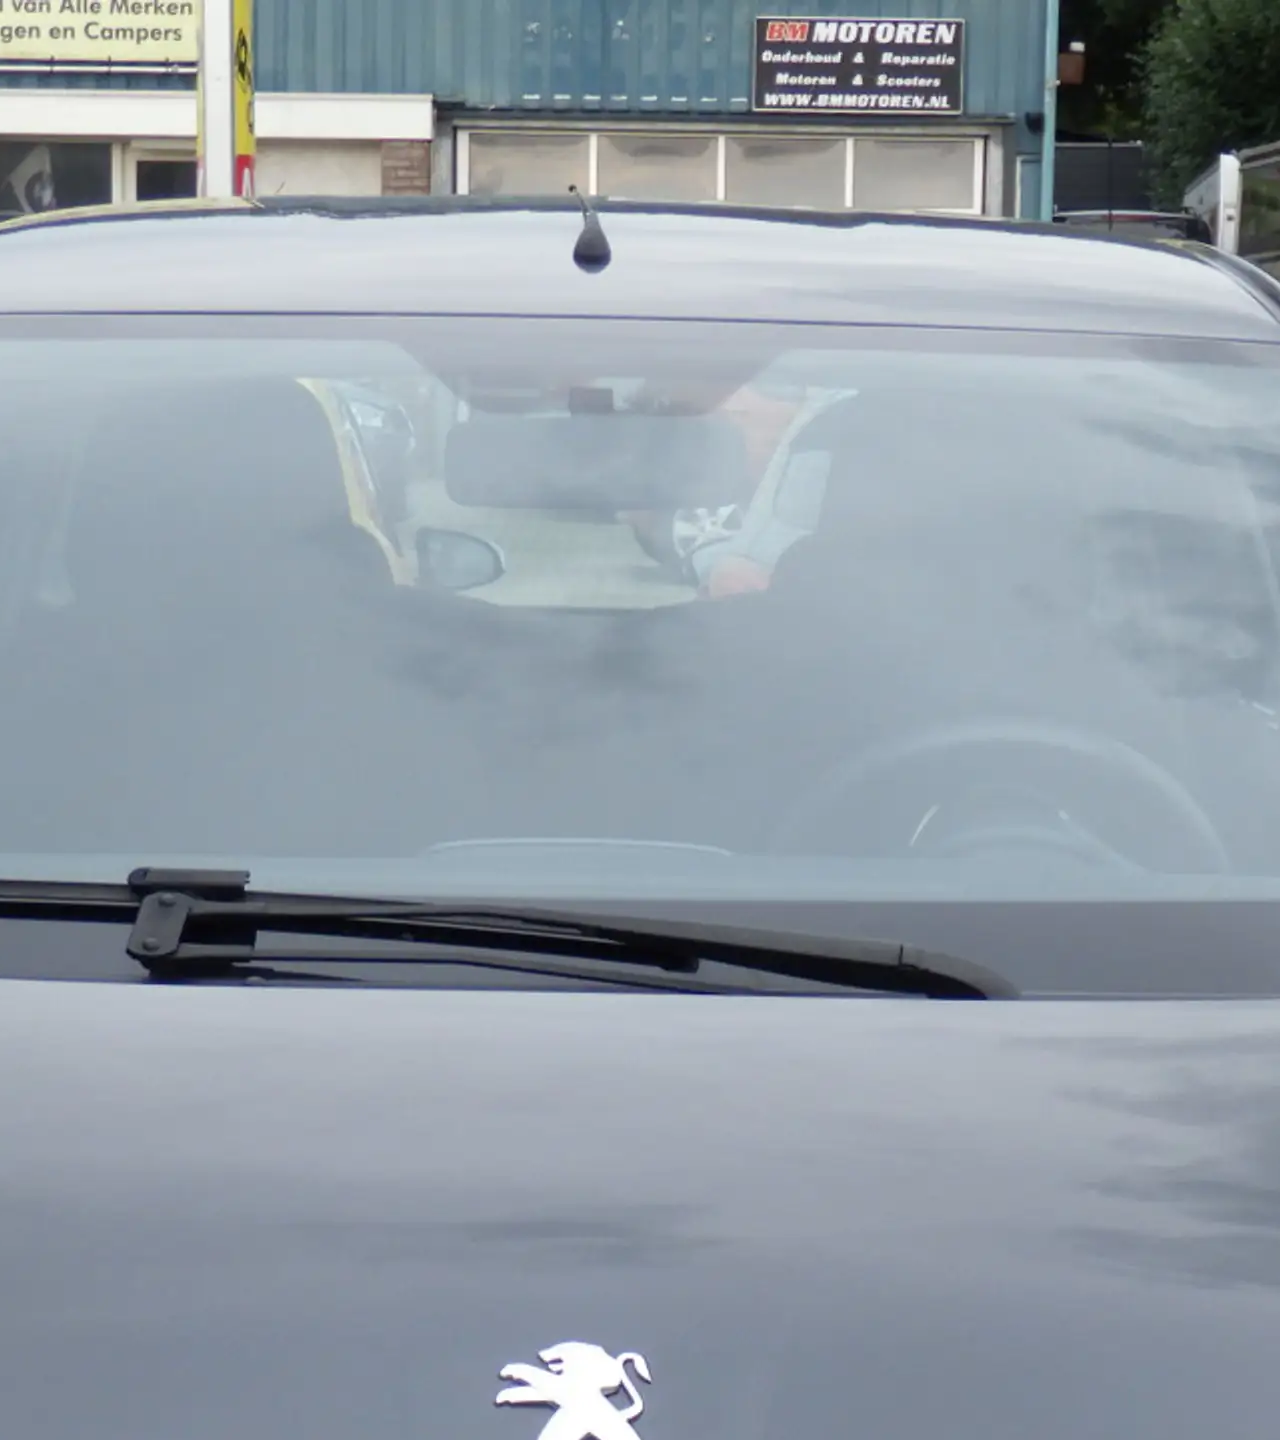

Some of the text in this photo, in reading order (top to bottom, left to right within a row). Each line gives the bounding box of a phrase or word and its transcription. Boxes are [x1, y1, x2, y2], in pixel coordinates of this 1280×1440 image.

[11, 0, 51, 13] van
[109, 0, 193, 15] Merken
[49, 25, 75, 39] en
[84, 22, 182, 44] Campers
[766, 21, 956, 44] BM MOTOREN
[762, 50, 956, 66] Onderhoud & Reparatie
[775, 72, 941, 87] Motoren & Scooters
[764, 93, 950, 108] WWW.BMMOTOREN.NL
